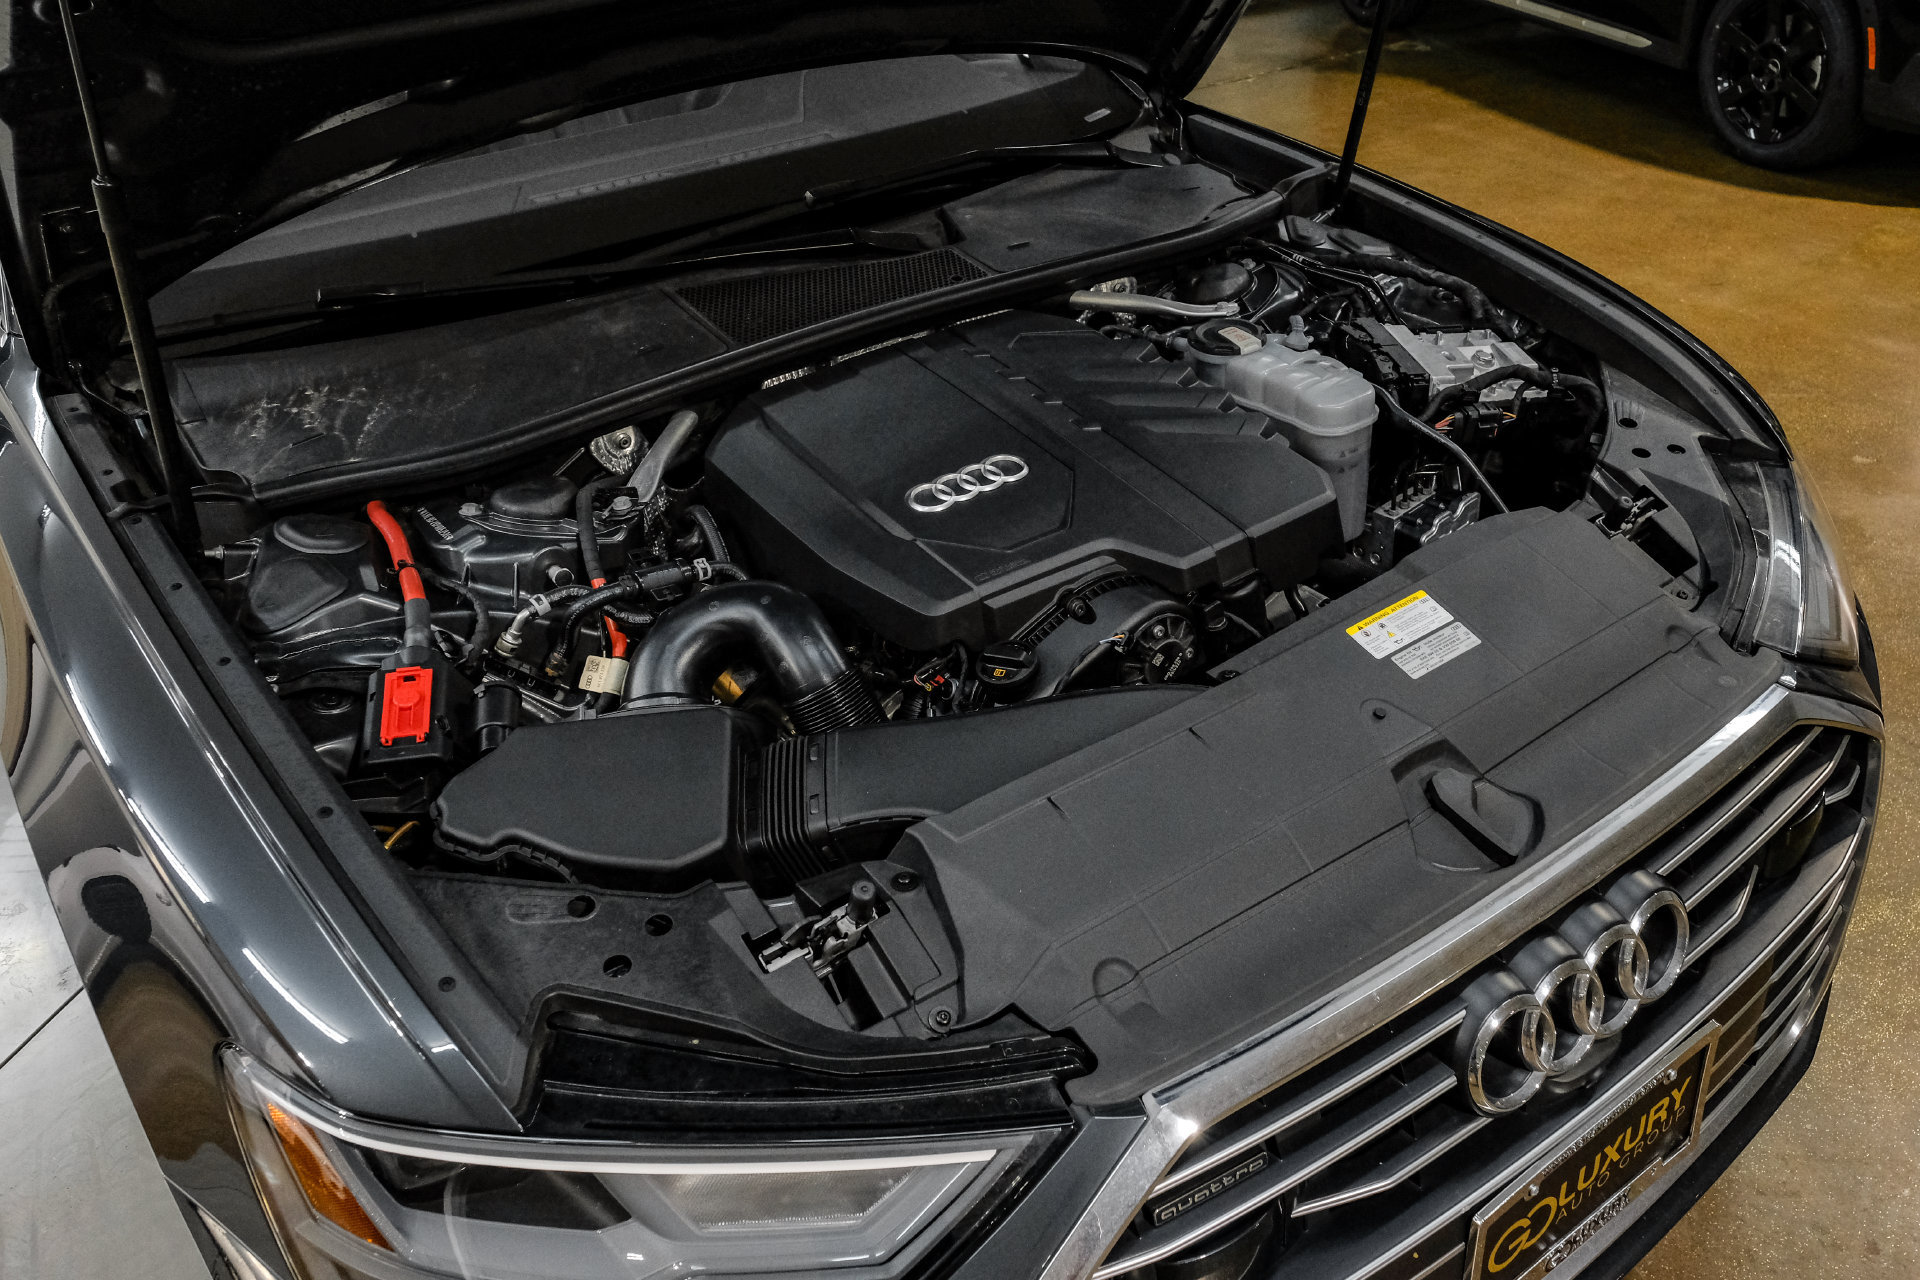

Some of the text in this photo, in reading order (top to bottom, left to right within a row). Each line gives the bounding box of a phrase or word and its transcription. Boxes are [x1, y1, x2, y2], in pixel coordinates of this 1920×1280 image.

[1363, 611, 1390, 627] WARNING
[1390, 596, 1419, 613] ATTENTION
[1161, 1159, 1264, 1221] quattro
[1555, 1171, 1610, 1225] AUTO
[1619, 1105, 1686, 1169] GROUP
